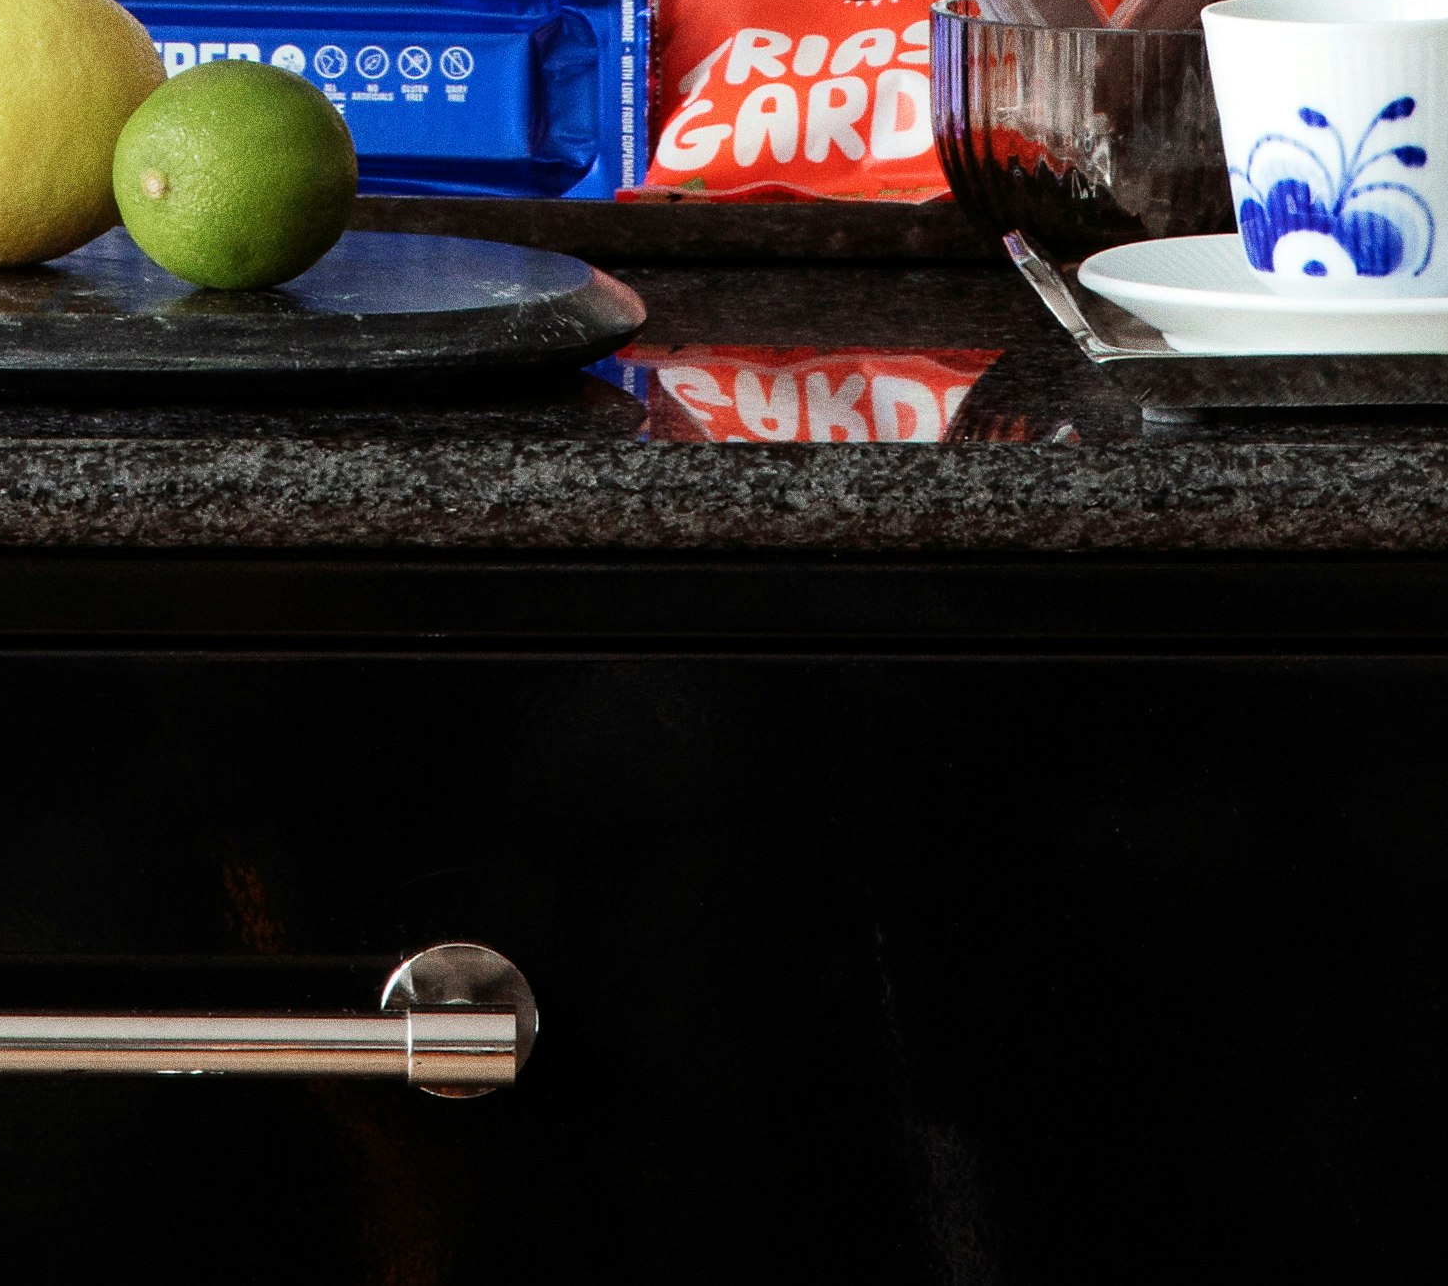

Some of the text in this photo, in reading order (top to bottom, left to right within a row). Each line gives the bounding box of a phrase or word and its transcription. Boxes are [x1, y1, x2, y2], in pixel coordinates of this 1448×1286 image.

[621, 55, 634, 80] WITH
[621, 82, 634, 105] LOVE
[621, 106, 634, 133] FROM
[657, 69, 934, 171] GARD
